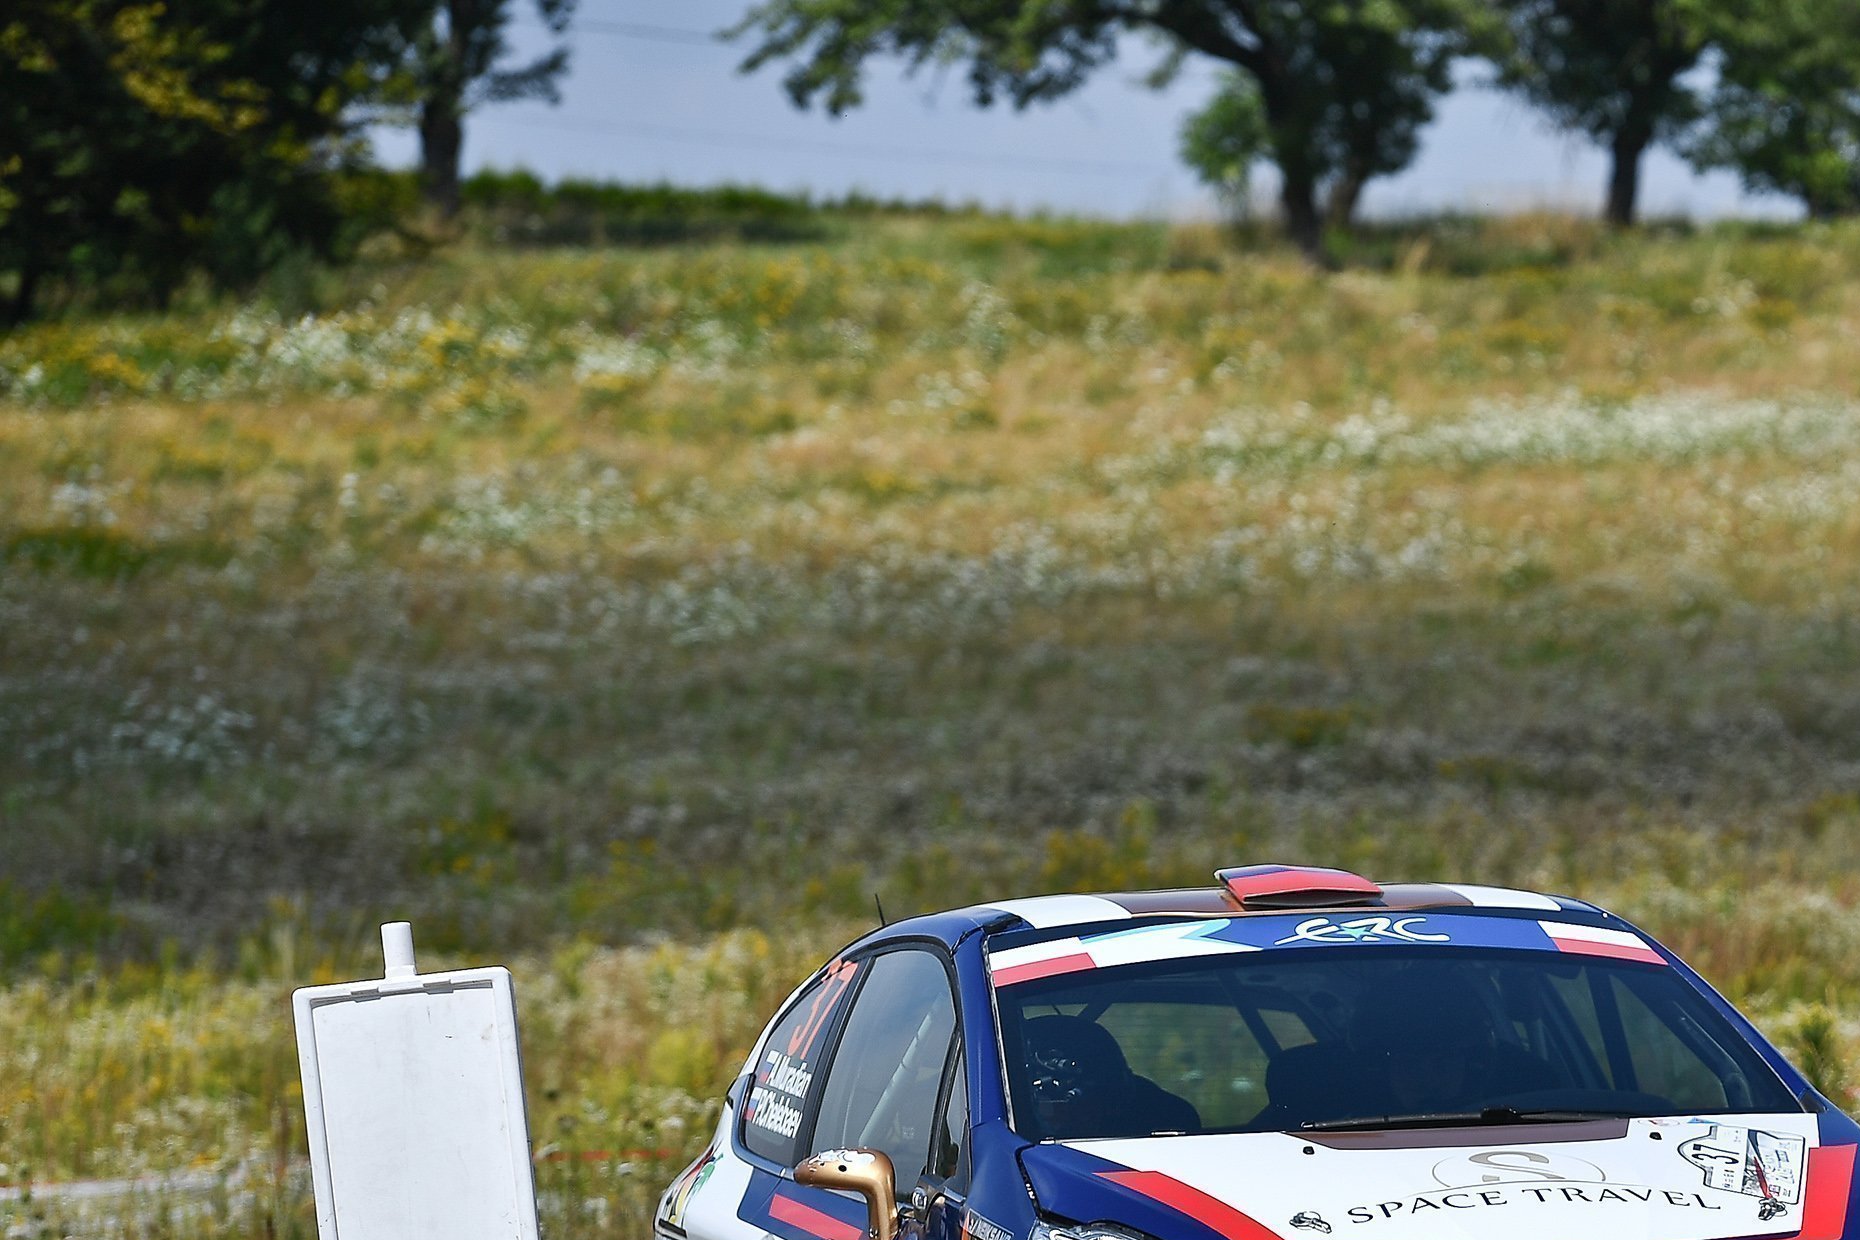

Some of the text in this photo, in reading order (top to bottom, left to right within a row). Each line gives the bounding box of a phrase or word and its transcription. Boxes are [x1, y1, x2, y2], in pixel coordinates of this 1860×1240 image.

[787, 960, 858, 1060] 37
[1691, 1143, 1740, 1165] 37
[1347, 1187, 1723, 1224] SPACE TRAVEL
